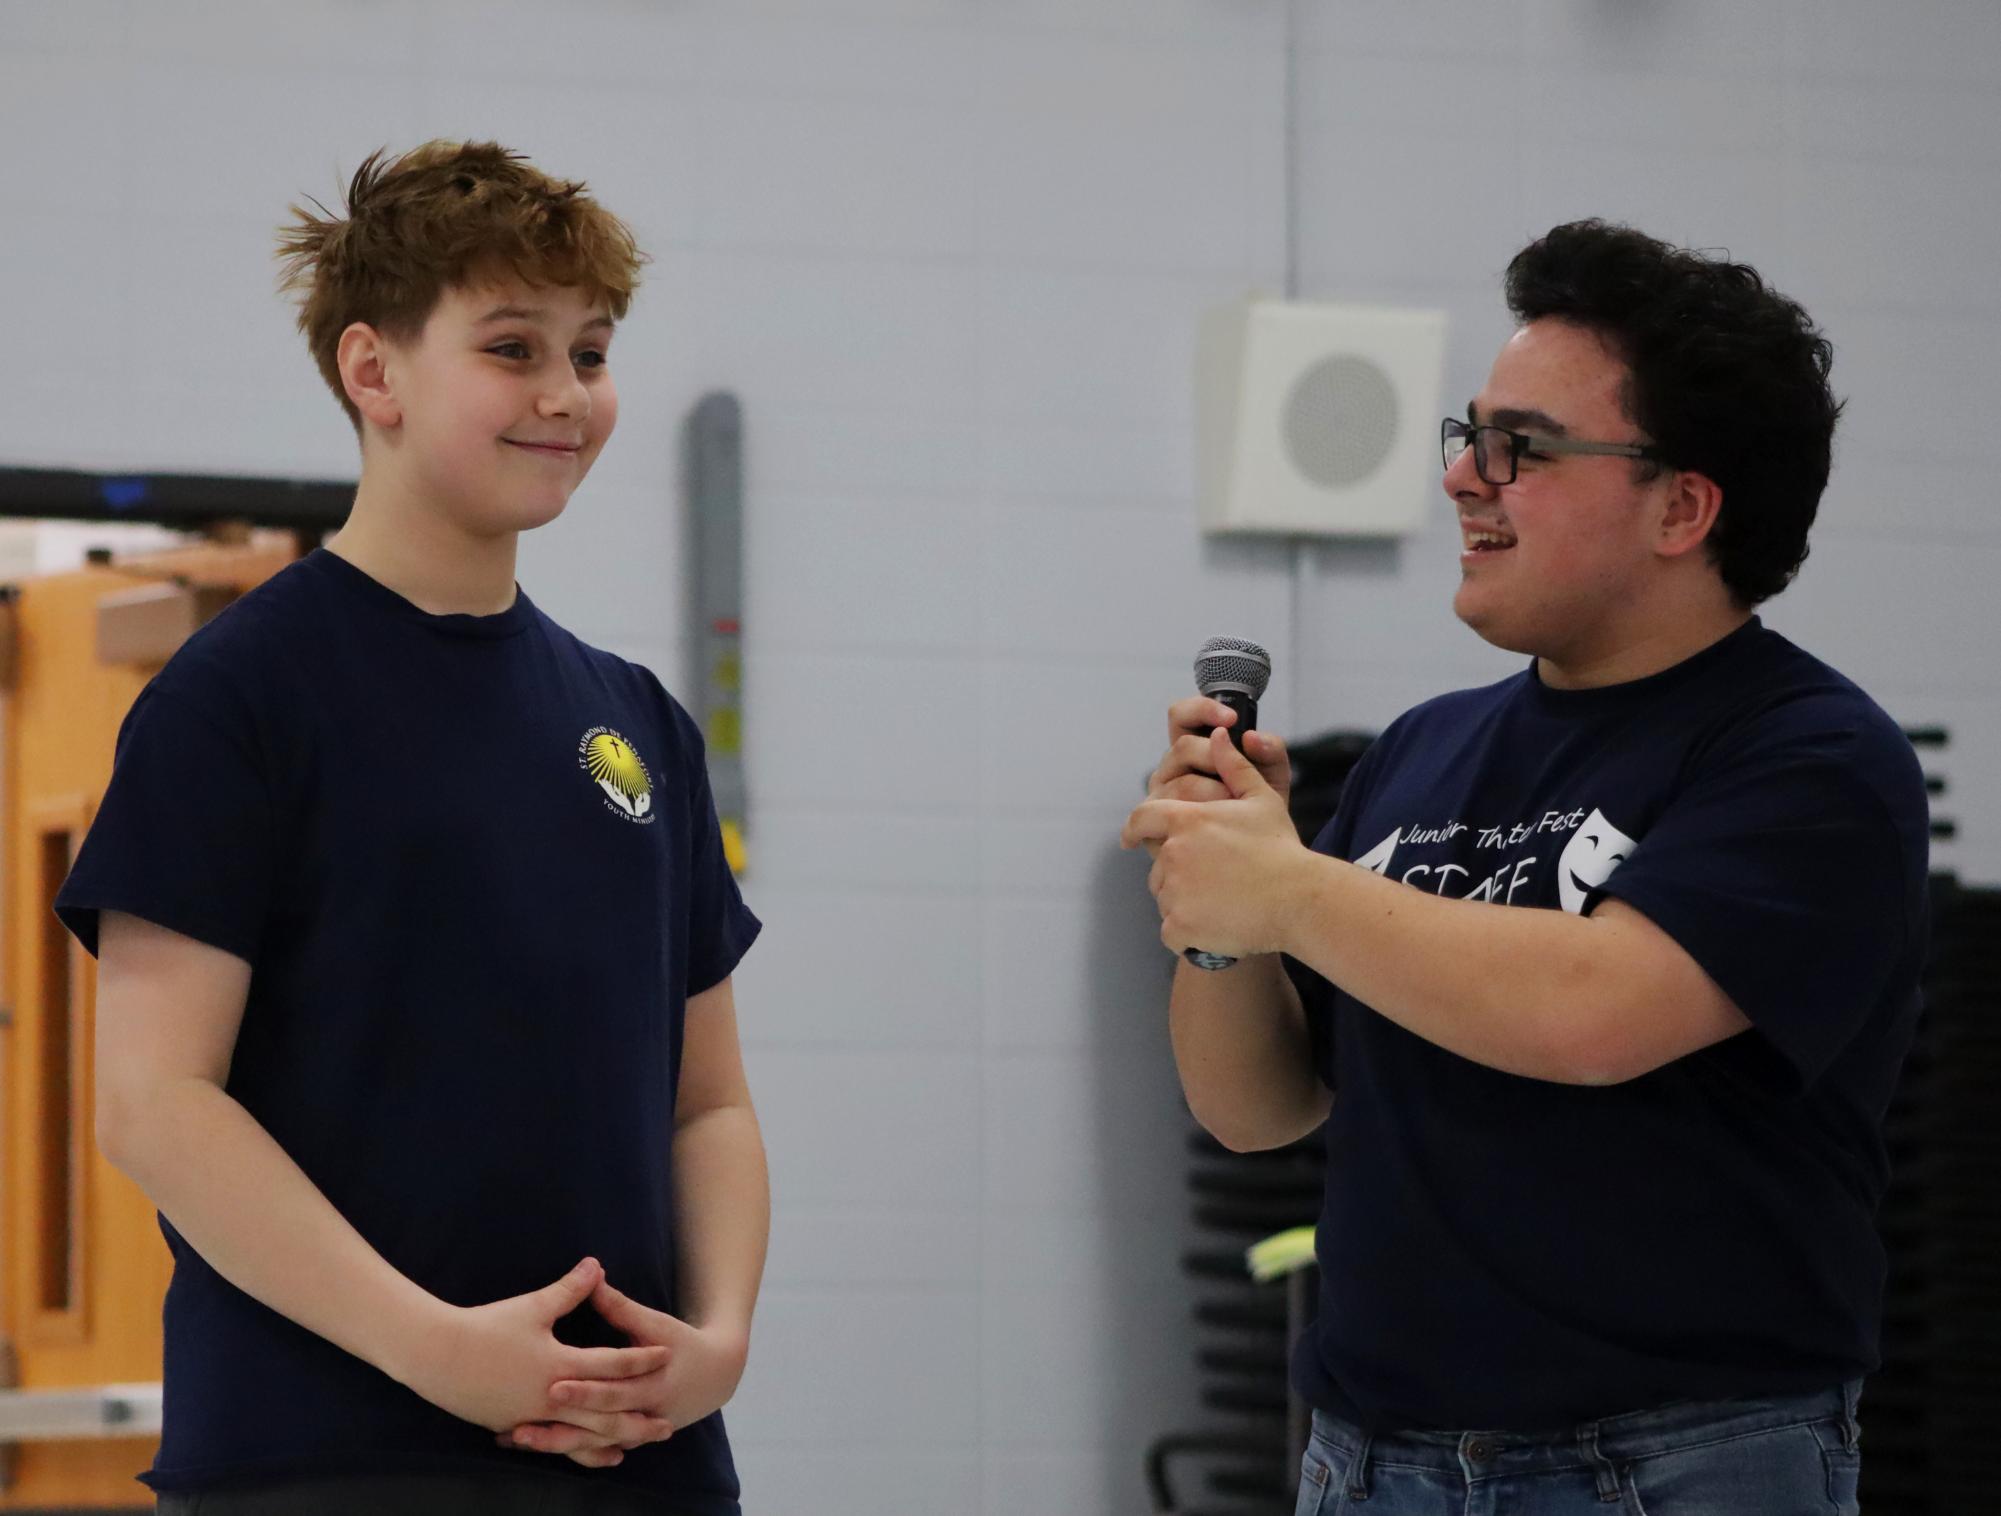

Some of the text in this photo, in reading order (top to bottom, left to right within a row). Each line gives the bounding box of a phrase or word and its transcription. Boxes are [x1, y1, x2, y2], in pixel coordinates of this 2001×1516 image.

[579, 726, 608, 754] RAYMOND
[603, 798, 630, 821] YOUTH
[1537, 807, 1585, 834] Fest
